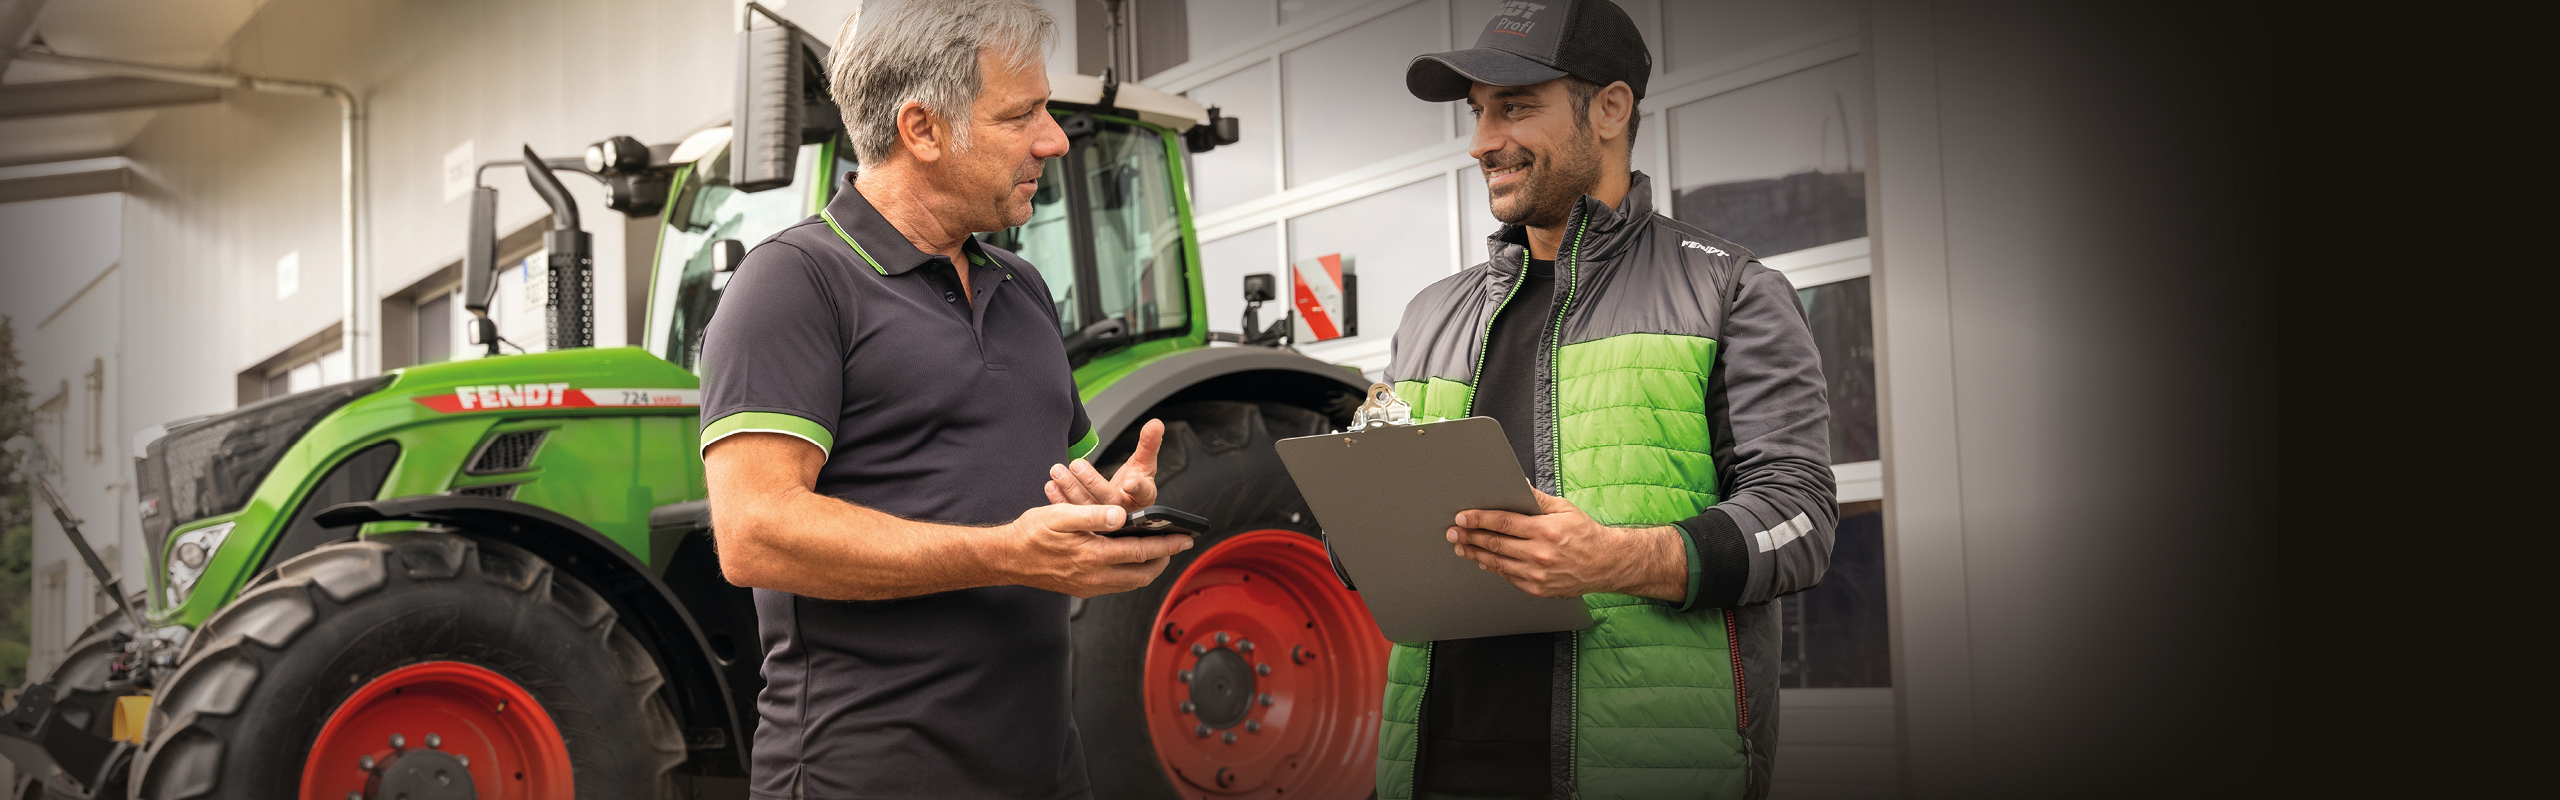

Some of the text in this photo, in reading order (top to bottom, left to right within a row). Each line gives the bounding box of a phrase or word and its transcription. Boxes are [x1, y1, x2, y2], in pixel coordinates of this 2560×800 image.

[1493, 0, 1546, 19] NDT
[1496, 18, 1535, 34] Profi
[1681, 240, 1730, 257] FENDT
[455, 383, 570, 409] FENDT
[622, 391, 648, 405] 724
